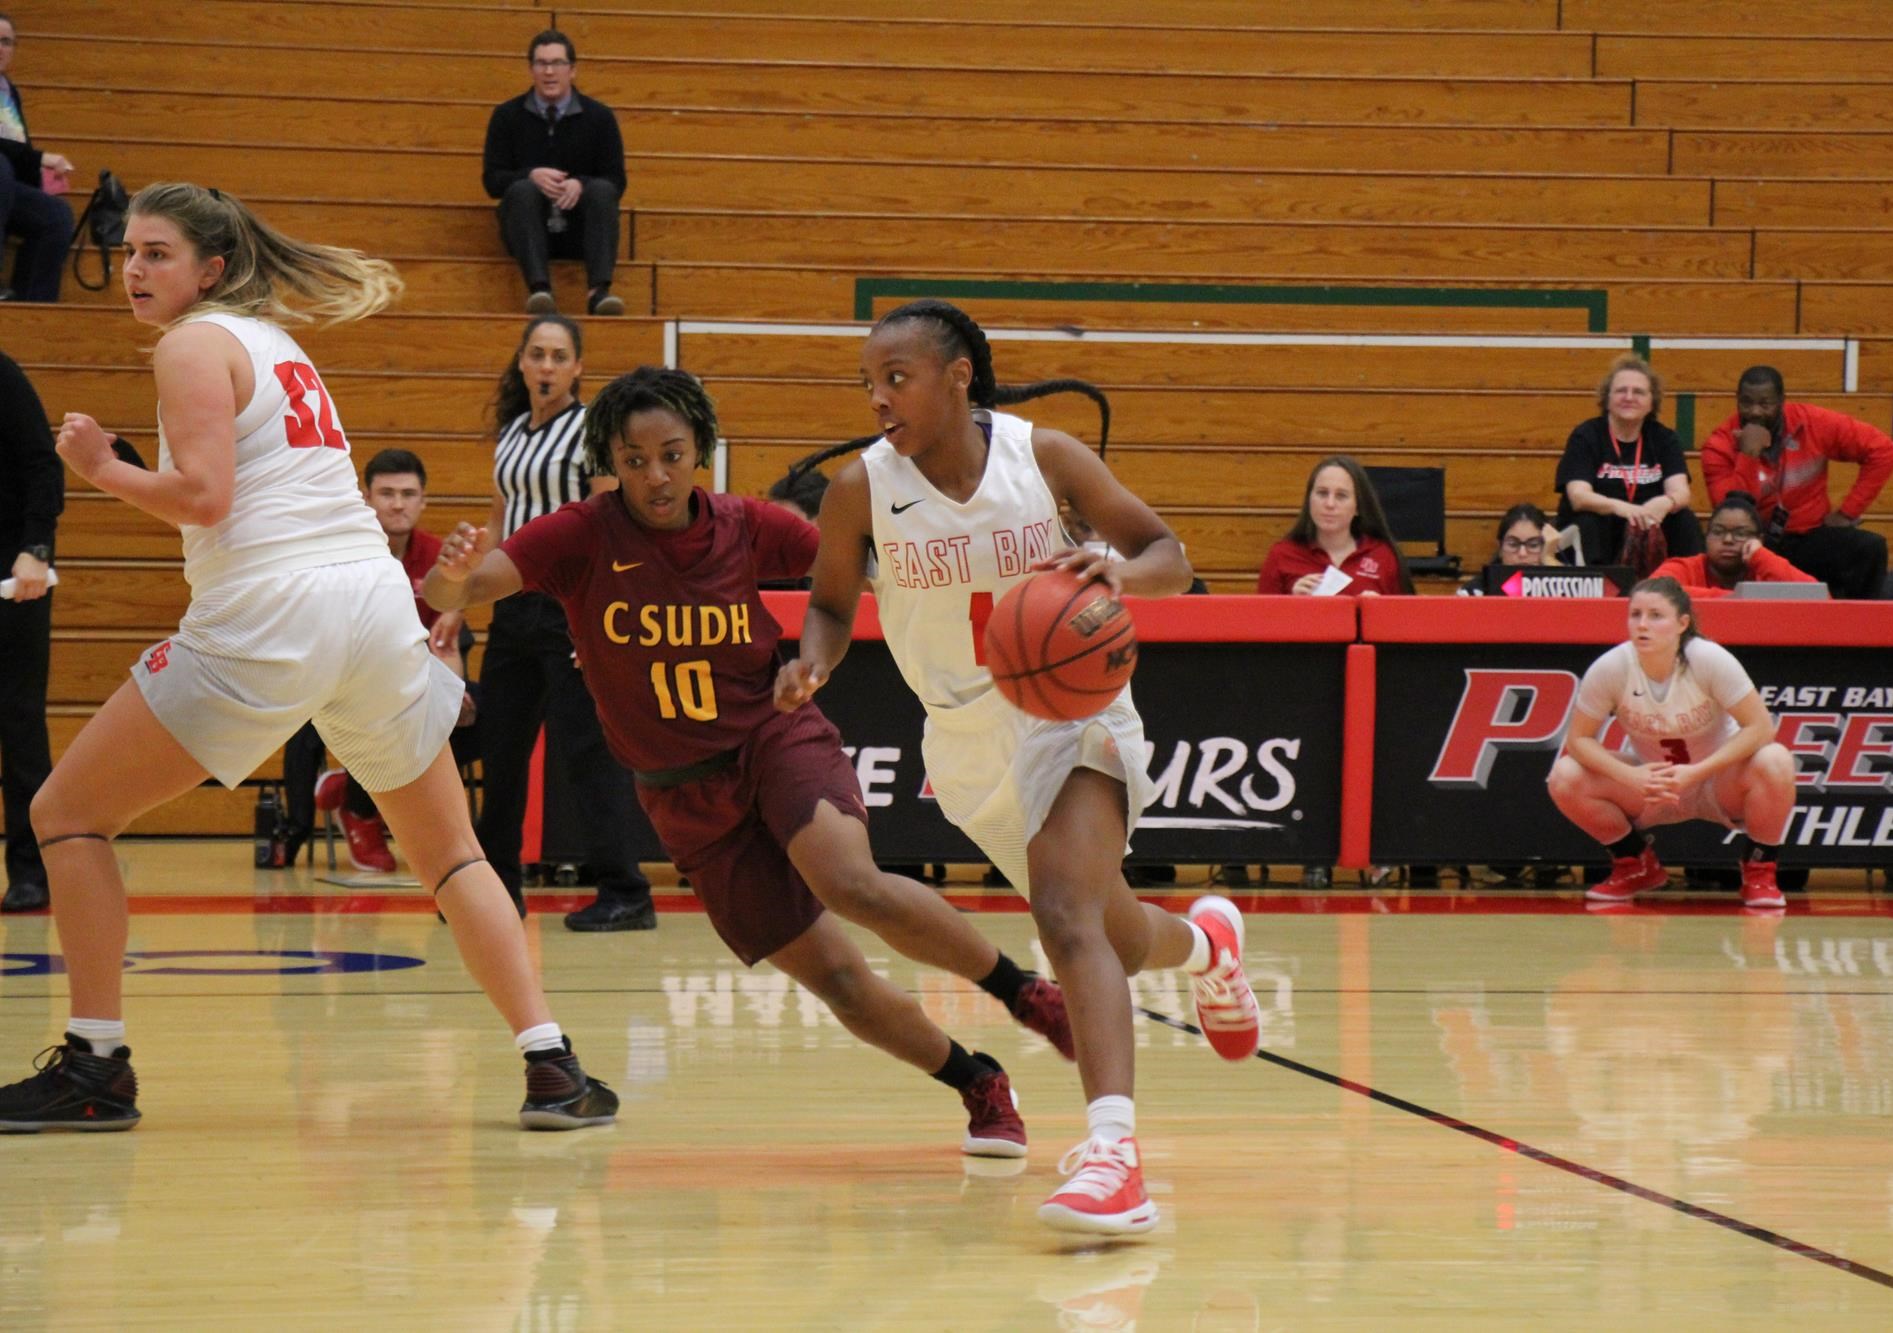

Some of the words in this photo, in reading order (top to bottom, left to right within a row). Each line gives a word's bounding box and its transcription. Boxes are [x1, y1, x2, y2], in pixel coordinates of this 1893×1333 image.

[273, 360, 347, 450] 32
[883, 535, 971, 589] EAST
[1522, 576, 1604, 597] POSSESSION
[603, 601, 752, 646] CSUDH
[651, 660, 718, 722] 10
[1759, 686, 1837, 707] EAST
[1660, 739, 1690, 764] 3
[1144, 737, 1301, 817] URS
